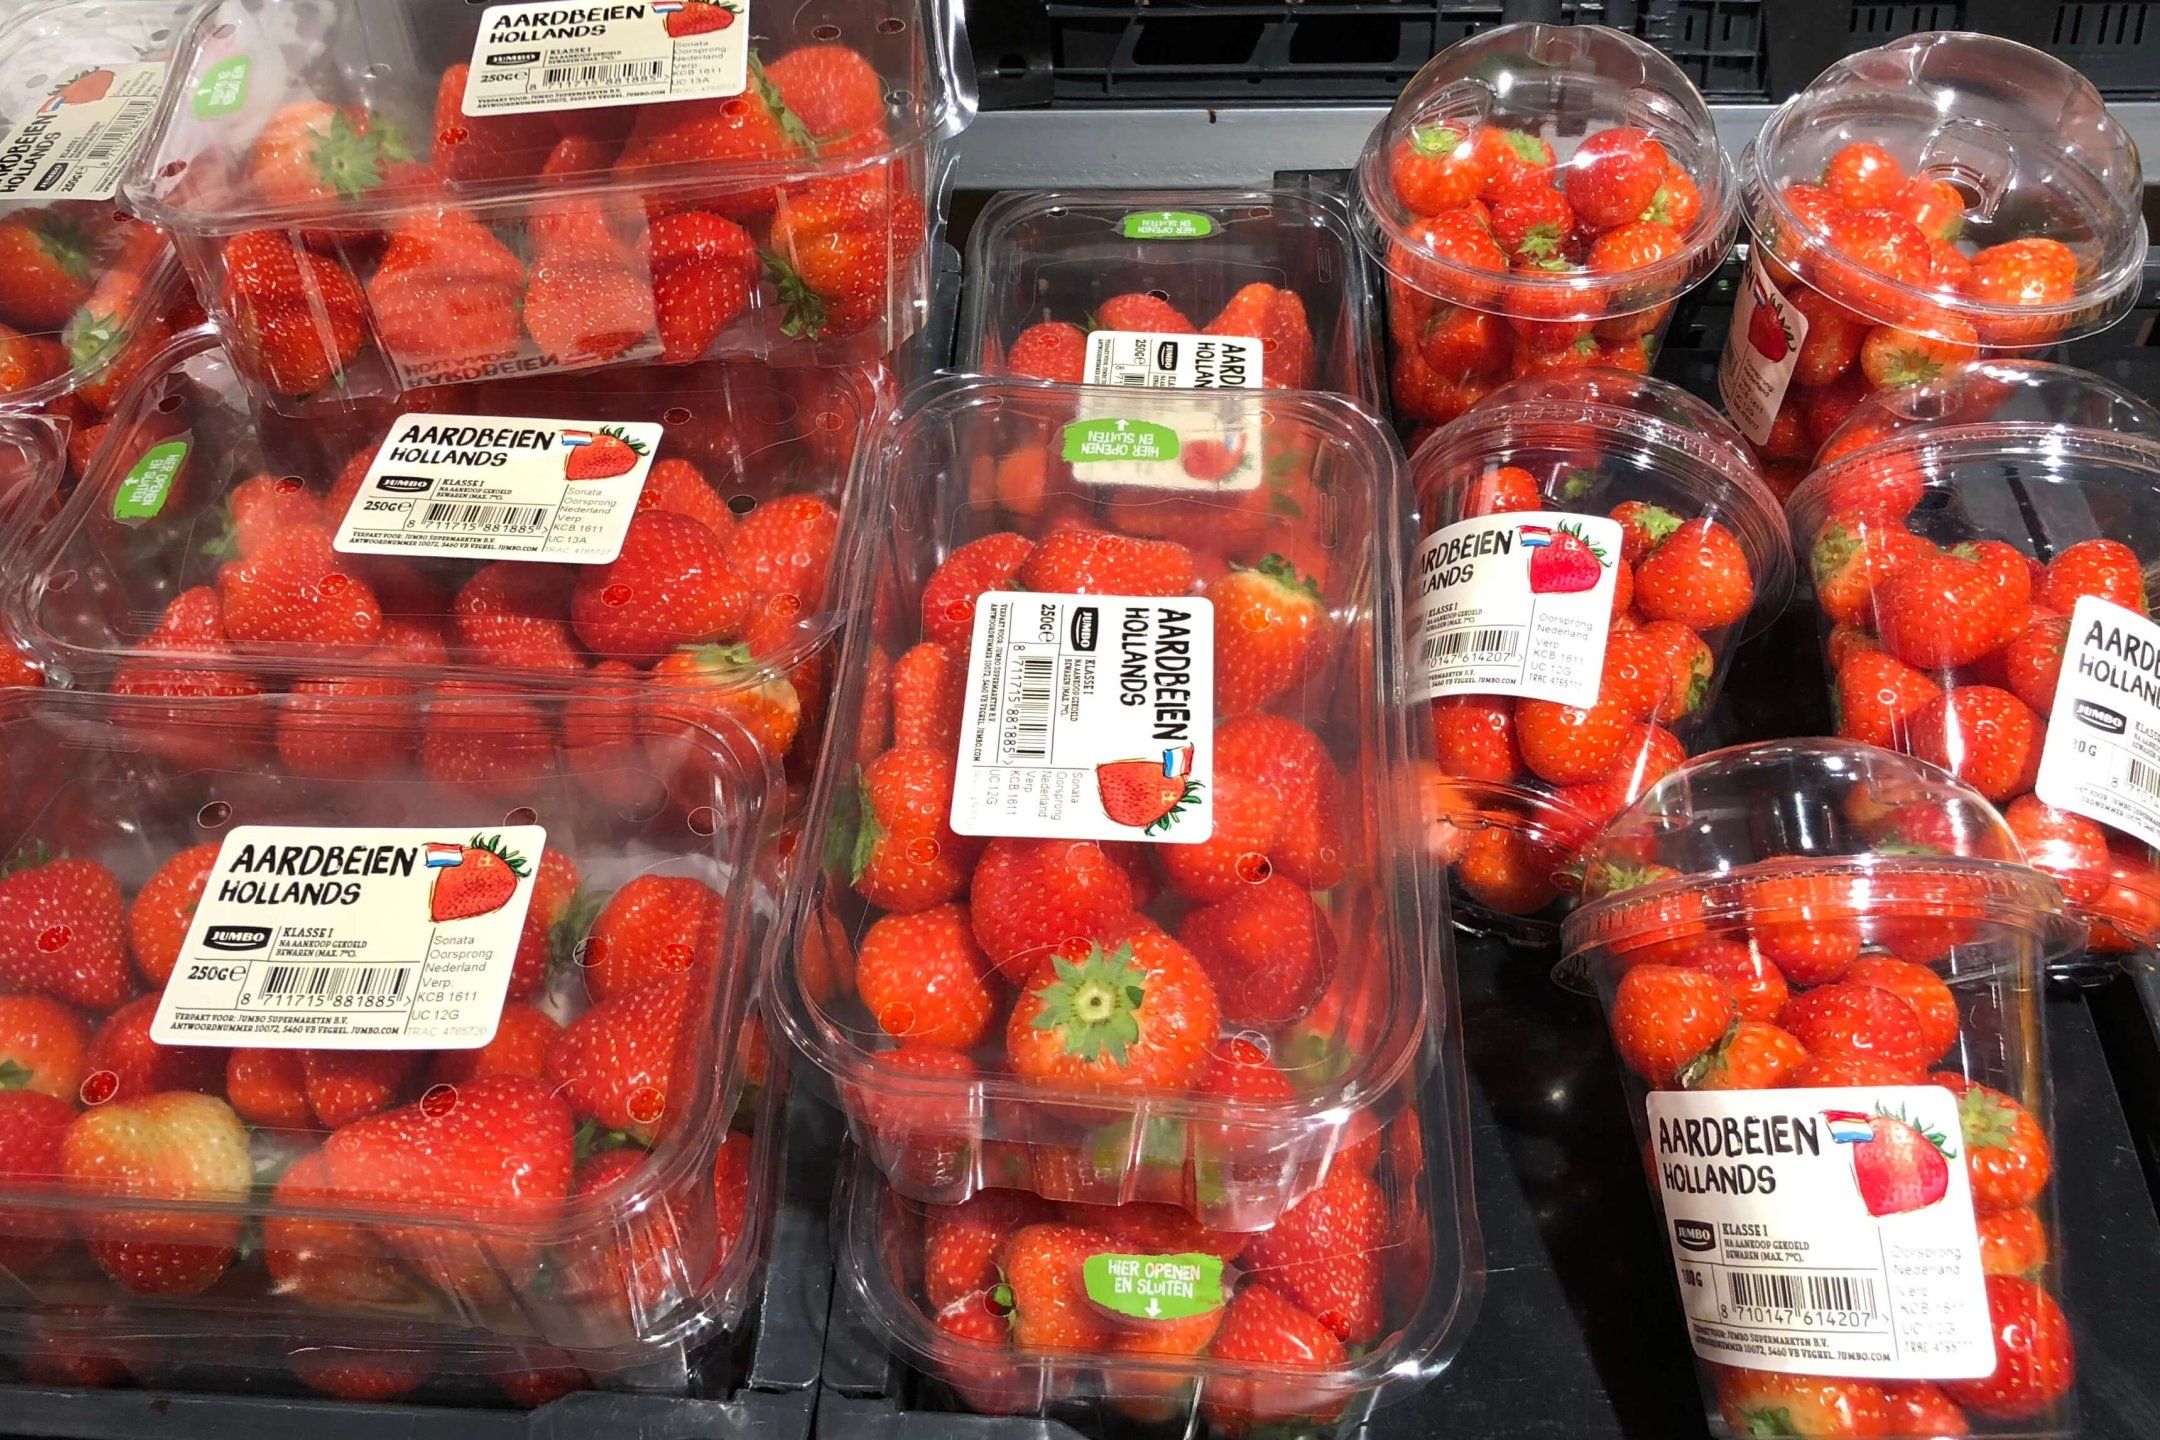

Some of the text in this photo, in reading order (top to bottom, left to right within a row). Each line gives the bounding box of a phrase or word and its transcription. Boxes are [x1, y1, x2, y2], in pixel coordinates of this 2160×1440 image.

[493, 5, 645, 29] AARDBEIEN
[490, 25, 606, 43] HOLLANDS
[0, 132, 62, 192] HOLLANDS
[398, 425, 556, 450] AARDBEIEN
[1088, 430, 1154, 445] EN SLUITEN
[390, 447, 508, 466] HOLLANDS
[1081, 443, 1160, 458] HIER OPENEN
[383, 479, 428, 488] JUMBO
[441, 478, 479, 486] KLASSE
[568, 488, 602, 496] Sonata
[563, 497, 617, 507] Oorsprong
[560, 506, 612, 515] Nederland
[406, 520, 536, 533] 8 711715 881885
[554, 523, 603, 533] KCB 1611
[568, 536, 587, 544] 13A
[1080, 611, 1093, 648] JUMBO
[1539, 613, 1593, 631] Oorsprong
[1536, 623, 1589, 640] Nederland
[1120, 608, 1149, 706] HOLLANDS
[1462, 652, 1511, 662] 614207
[1533, 649, 1556, 660] KCB
[1009, 660, 1024, 703] 711715
[1084, 659, 1096, 690] KLASSE
[1152, 608, 1192, 740] AARDBEIEN
[2076, 704, 2123, 728] JUMBO
[1003, 709, 1019, 754] 881885
[1006, 770, 1021, 815] KCB 1611
[1038, 770, 1052, 818] Nederland
[1071, 772, 1083, 804] Sonata
[1051, 771, 1067, 821] Oorsprong
[229, 844, 418, 877] AARDBEIEN
[218, 880, 361, 906] HOLLANDS
[211, 931, 265, 942] JUMBO
[283, 928, 334, 938] KLASSE I
[433, 935, 475, 945] Sonata
[291, 940, 331, 948] AANKOOP
[332, 940, 368, 948] GEKOELD
[276, 949, 313, 957] BEWAREN
[430, 949, 493, 960] Oorsprong
[425, 961, 487, 972] Nederland
[241, 993, 397, 1008] 8 711715 881885
[417, 991, 477, 1002] KCB 1611
[175, 1012, 211, 1020] VERPAKT
[212, 1014, 237, 1022] VOOR:
[239, 1014, 266, 1023] JUMBO
[267, 1015, 331, 1024] SUPERMARKTEN
[411, 1009, 460, 1020] UC 12G
[170, 1022, 253, 1032] ANTWOORDNUMMER
[282, 1025, 302, 1033] 5460
[304, 1025, 316, 1033] VB
[350, 1026, 399, 1035] JUMBO.COM
[1659, 1115, 1819, 1158] AARDBEIEN
[1662, 1162, 1776, 1195] HOLLANDS
[1678, 1226, 1710, 1240] JUMBO
[1722, 1223, 1768, 1237] KLASSE I
[1735, 1239, 1771, 1249] AANKOOP
[1773, 1240, 1809, 1250] GEKOELD
[1108, 1259, 1200, 1280] HIER OPENEN
[1115, 1277, 1194, 1298] EN SLUITEN
[1720, 1304, 1870, 1327] 8 710147 614207
[1750, 1333, 1811, 1347] SUPERMARKTEN
[1813, 1338, 1829, 1348] B.V.
